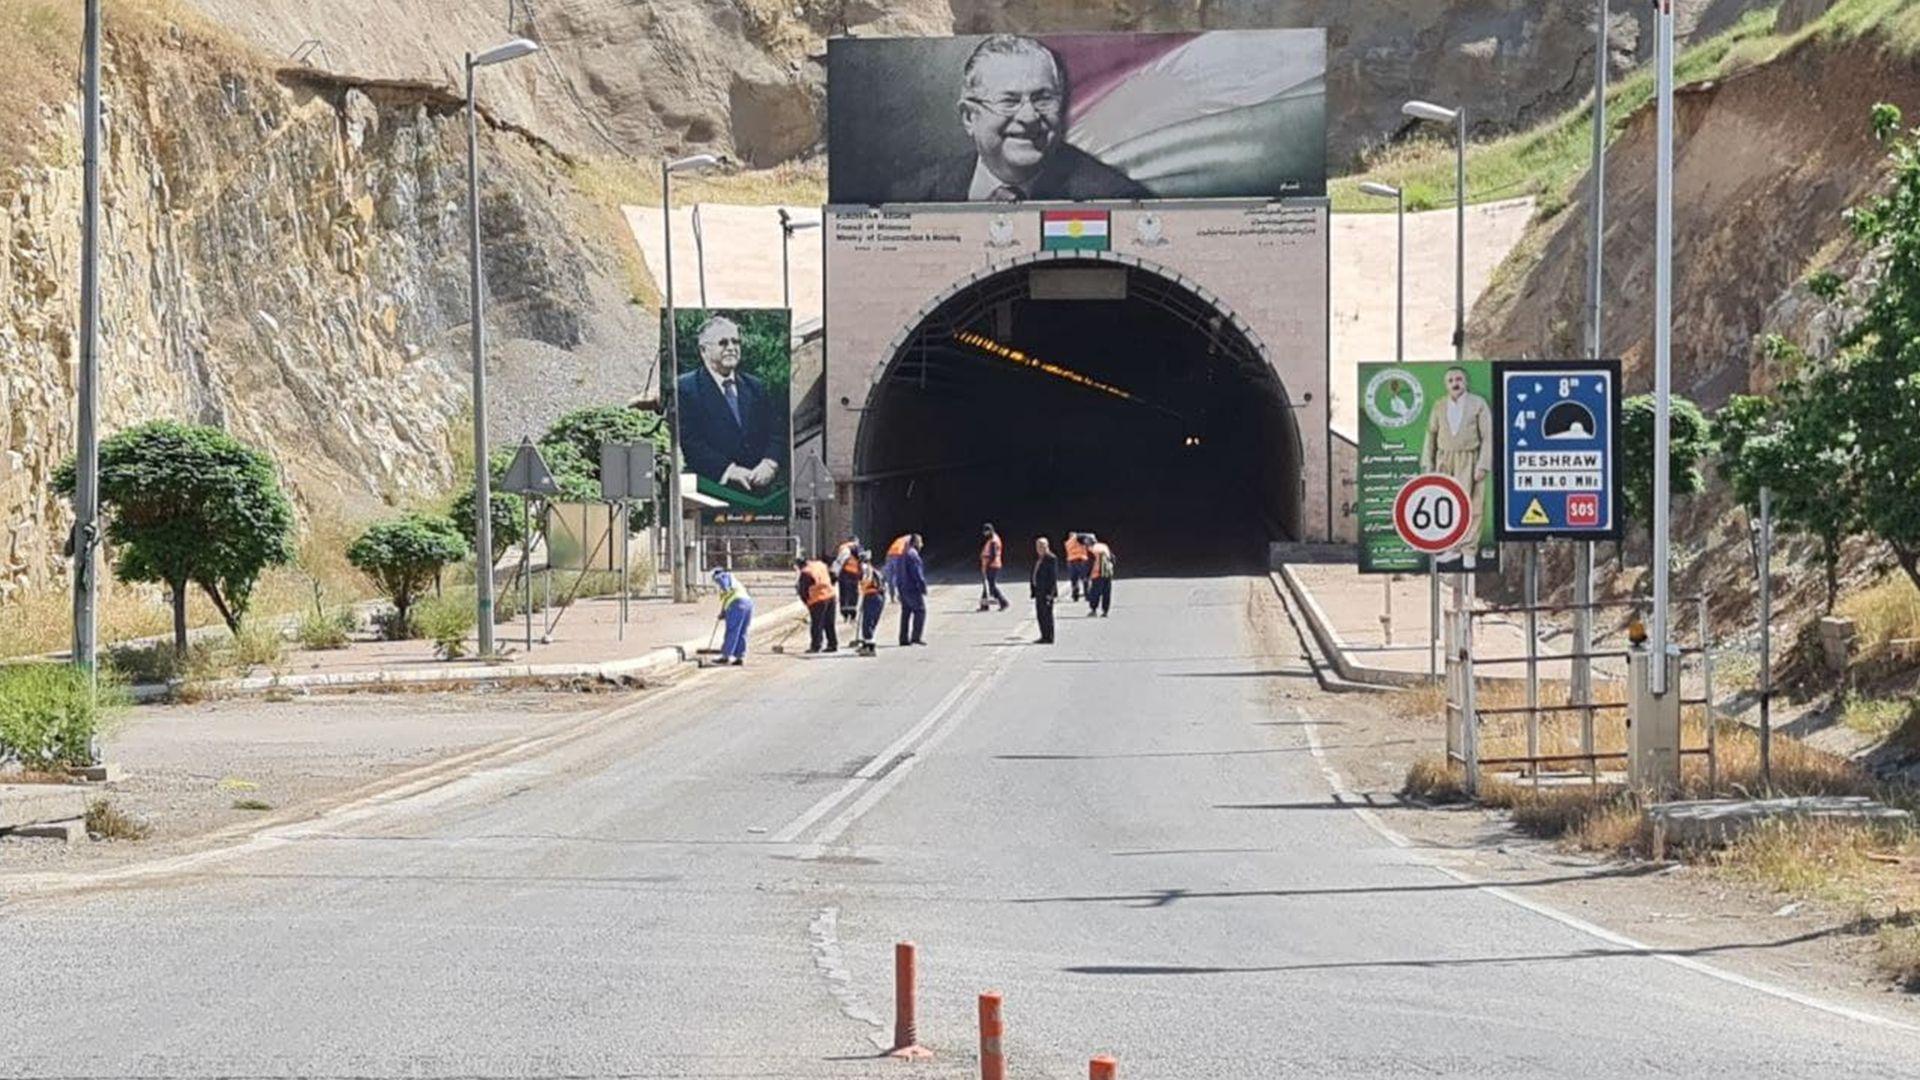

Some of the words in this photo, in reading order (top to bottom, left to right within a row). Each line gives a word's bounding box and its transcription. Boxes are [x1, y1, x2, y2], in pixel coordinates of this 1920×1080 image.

[1517, 455, 1598, 467] PESHRAW
[1517, 476, 1533, 487] FM
[1412, 496, 1454, 530] 60
[1570, 503, 1595, 517] SOS
